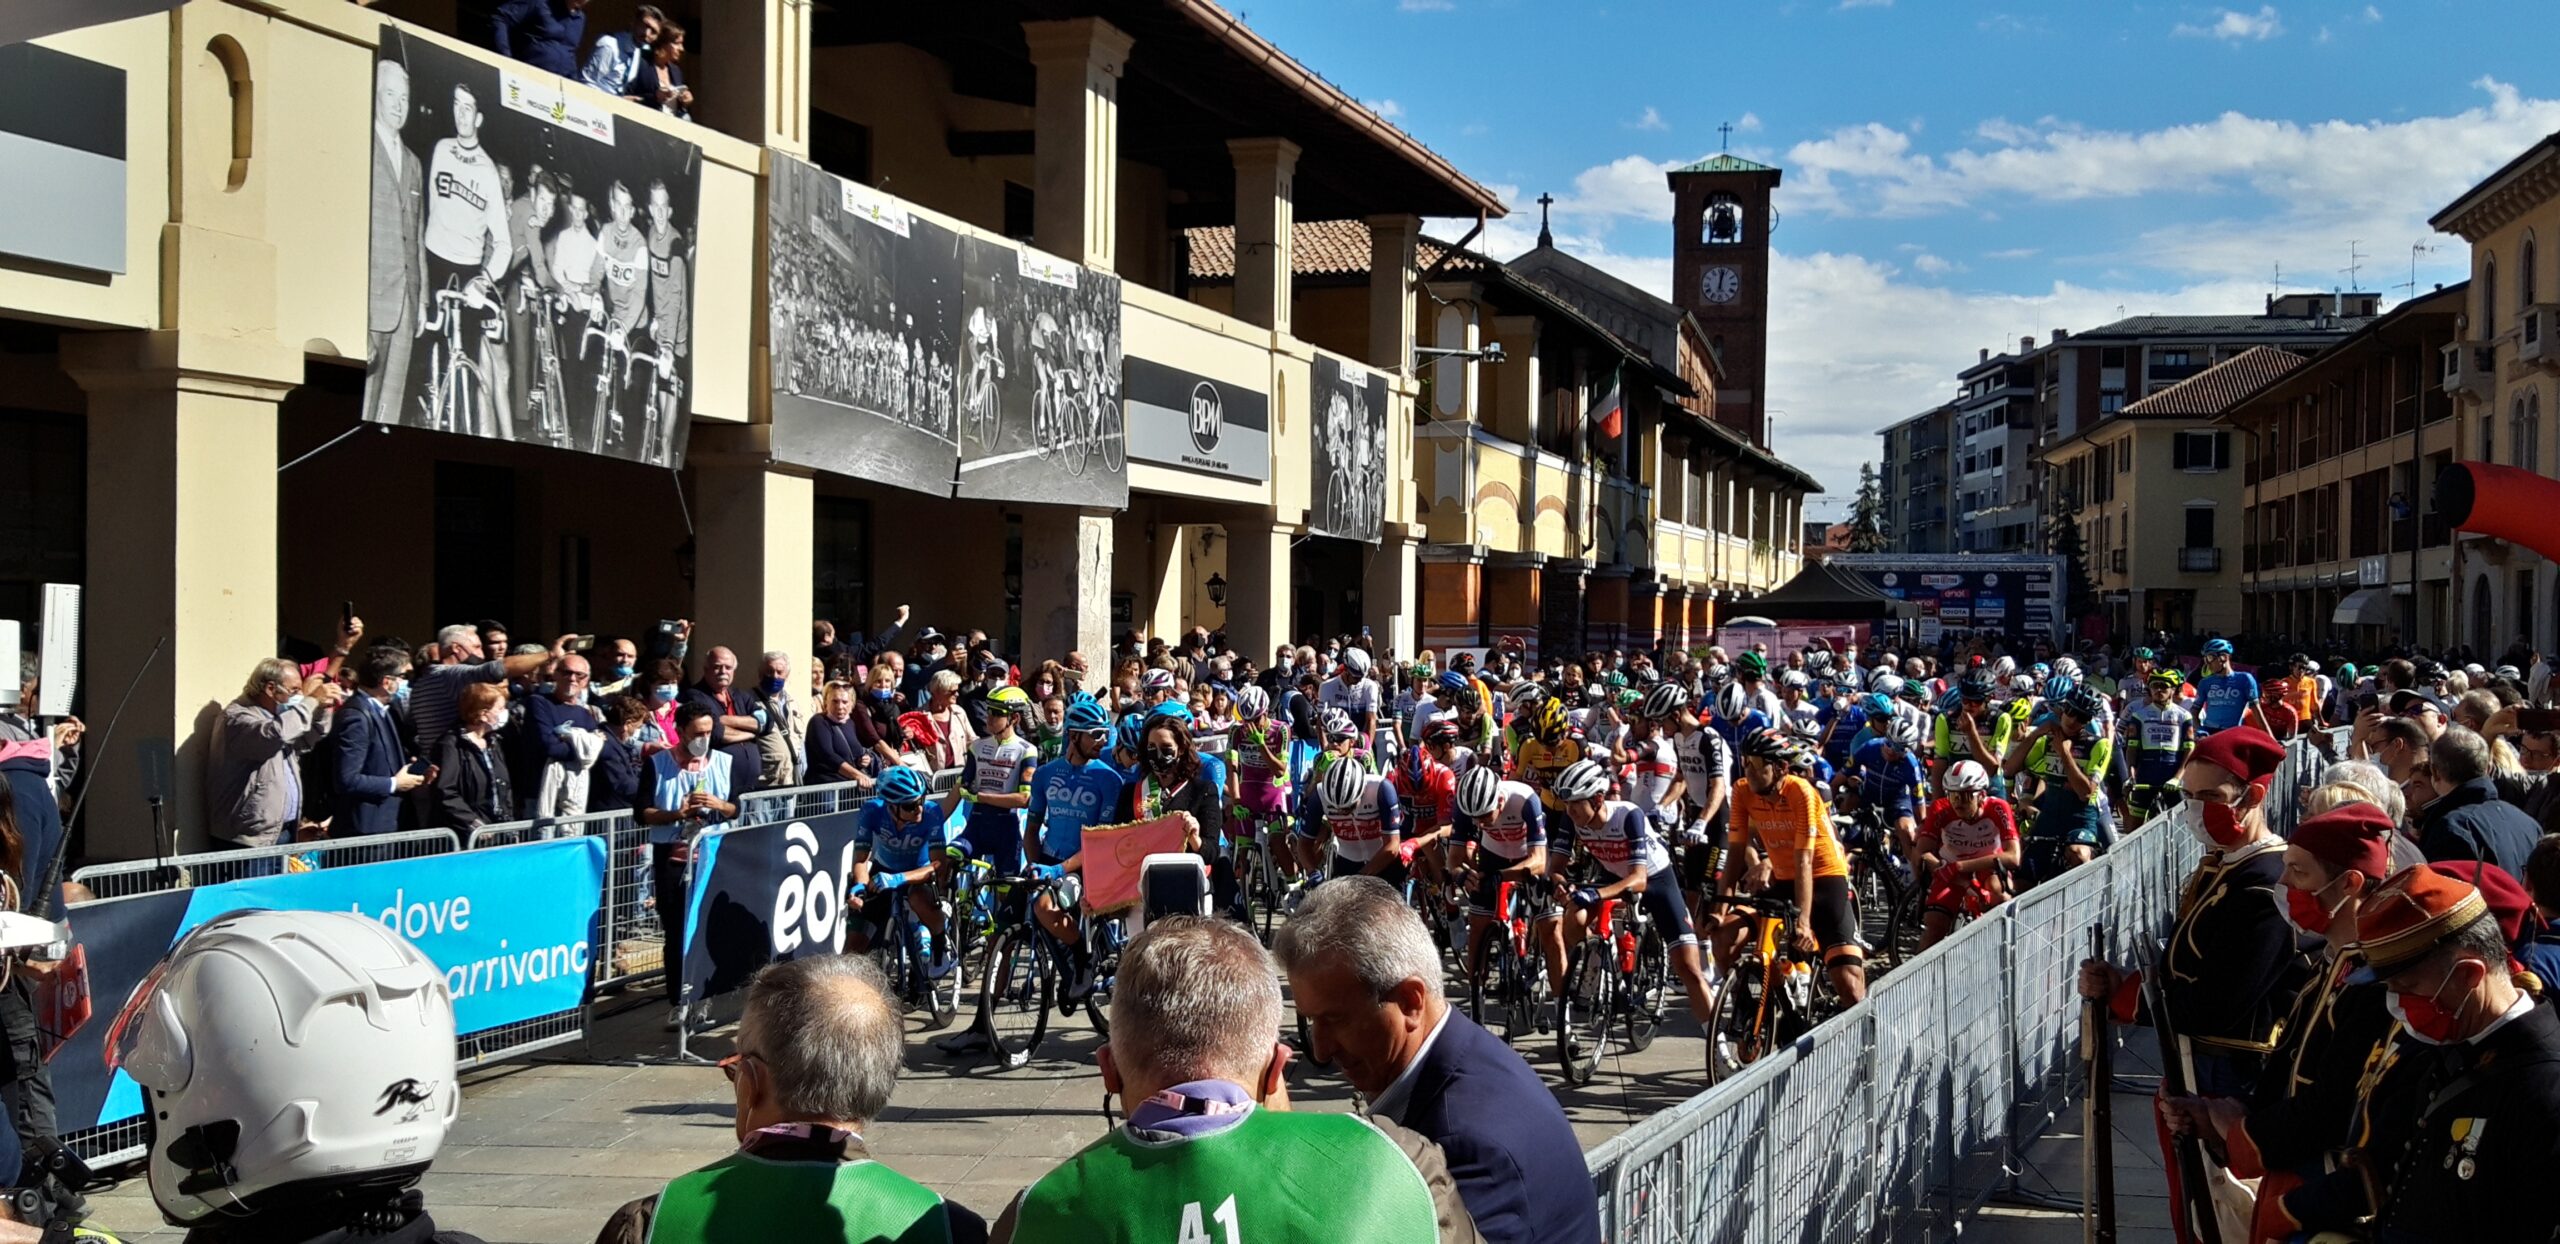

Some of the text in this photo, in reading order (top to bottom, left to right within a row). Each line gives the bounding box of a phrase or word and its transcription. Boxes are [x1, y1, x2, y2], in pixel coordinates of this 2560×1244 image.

[1193, 396, 1221, 438] BPM
[1942, 608, 1967, 616] TOYOTA
[1046, 785, 1096, 807] eolo
[379, 888, 471, 939] dove
[1177, 1192, 1241, 1244] 41
